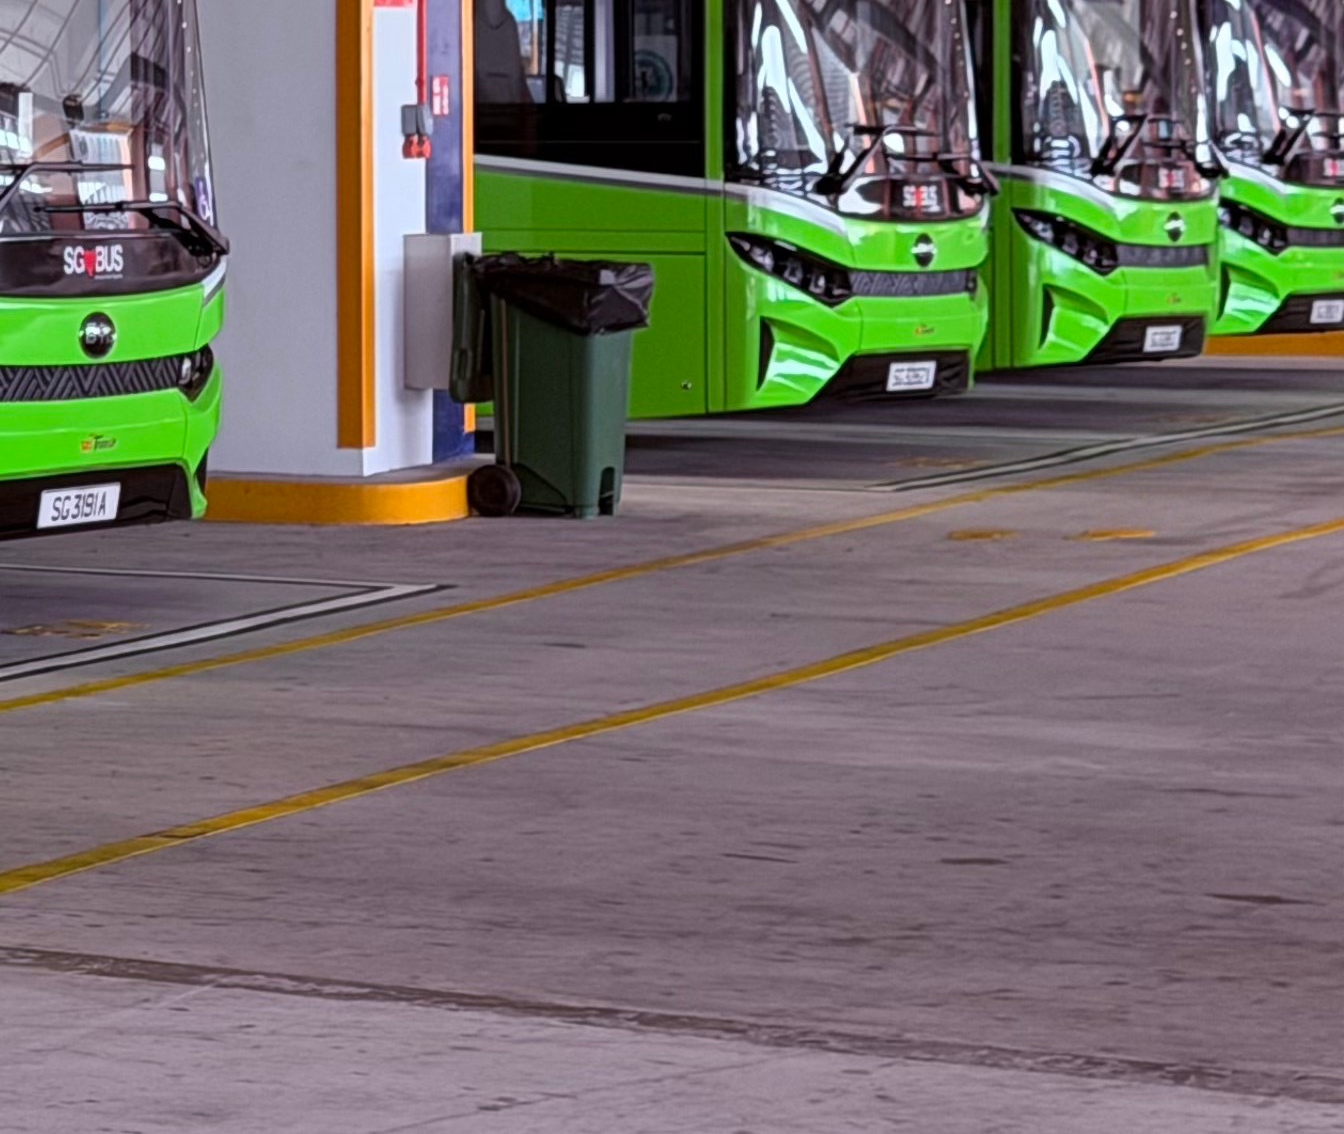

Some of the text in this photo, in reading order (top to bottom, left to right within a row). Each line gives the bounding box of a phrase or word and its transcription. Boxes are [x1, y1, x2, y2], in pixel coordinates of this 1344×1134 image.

[63, 244, 124, 275] SG BUS
[51, 491, 107, 522] SG3191A
